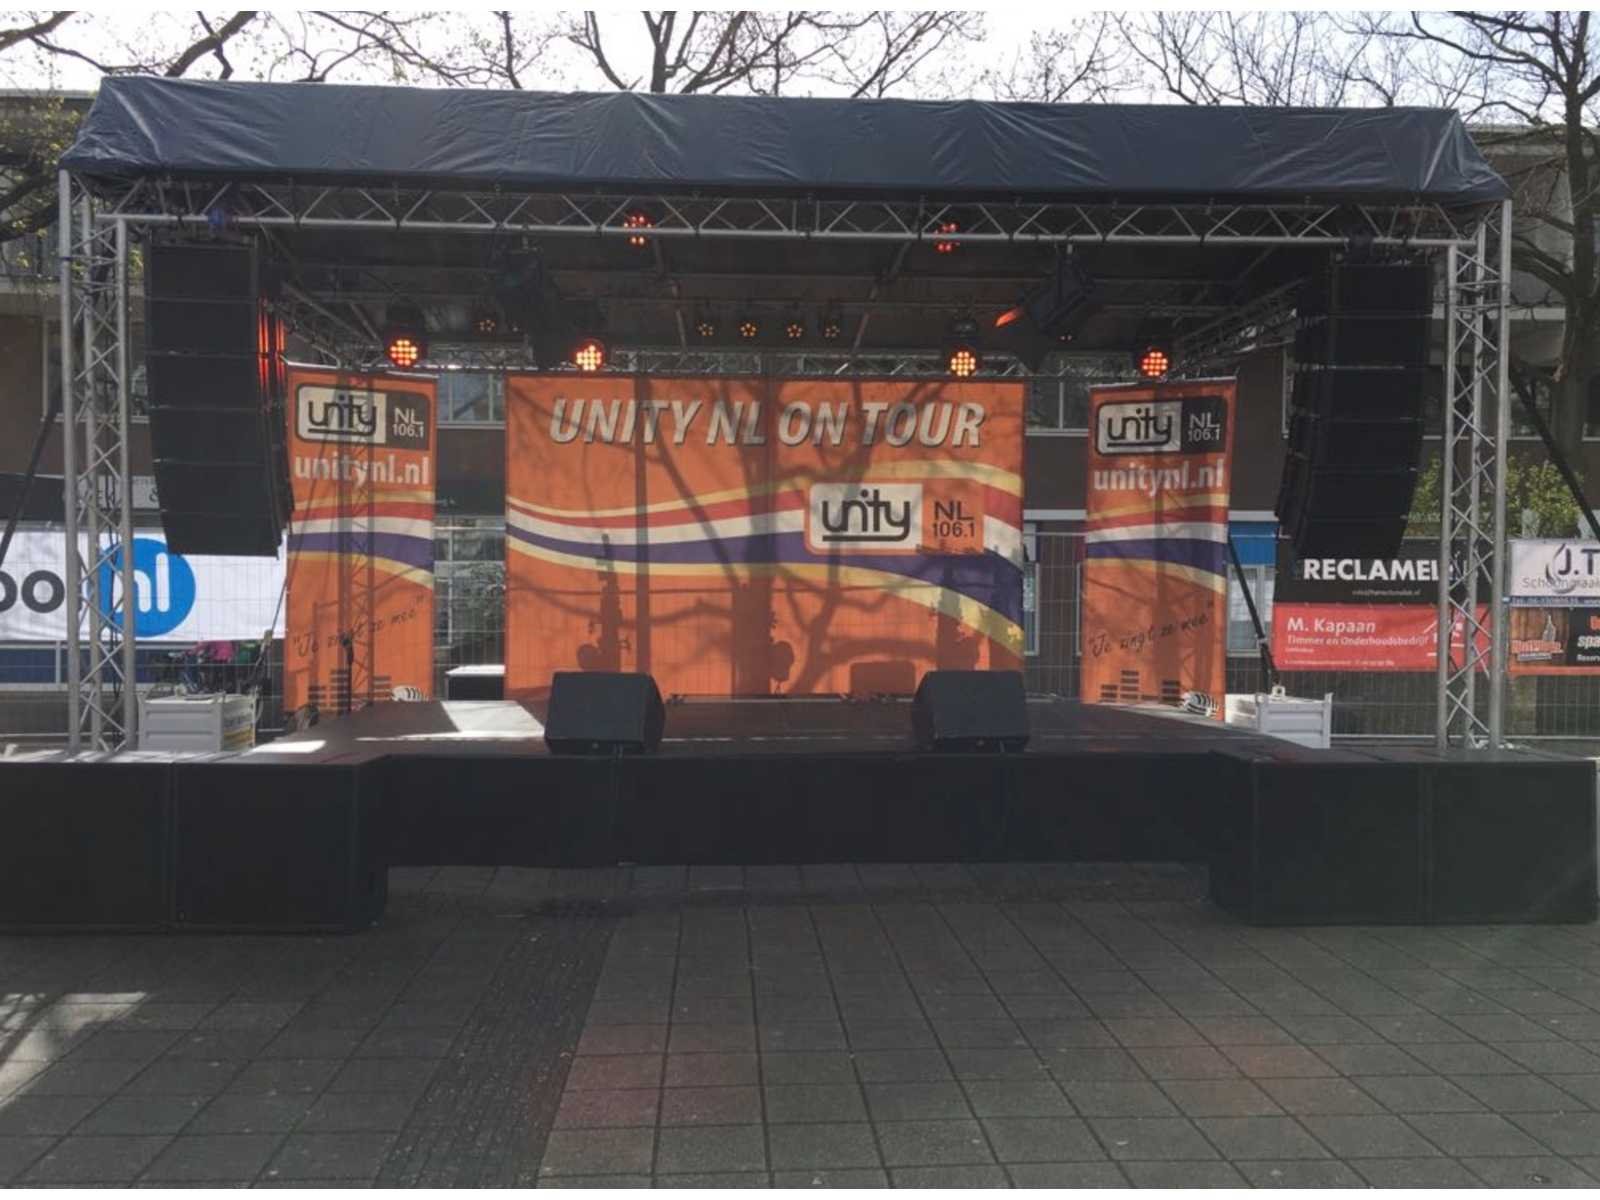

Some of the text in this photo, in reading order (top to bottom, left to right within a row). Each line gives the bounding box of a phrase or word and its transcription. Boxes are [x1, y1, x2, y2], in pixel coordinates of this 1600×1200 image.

[308, 394, 376, 436] unity
[394, 407, 424, 425] NL
[548, 398, 987, 450] UNITY NL ON TOUR
[1190, 412, 1220, 429] NL
[392, 424, 425, 438] 106.1
[1107, 408, 1172, 447] unity
[1188, 428, 1221, 442] 106.1
[294, 451, 430, 491] unitynl.nl
[1094, 459, 1224, 497] unitynl.nl
[822, 489, 911, 542] unity
[935, 500, 974, 521] NL
[932, 521, 976, 537] 106.1
[1287, 617, 1376, 636] M. Kapaan
[1287, 634, 1324, 646] Timmer
[1326, 636, 1339, 646] en
